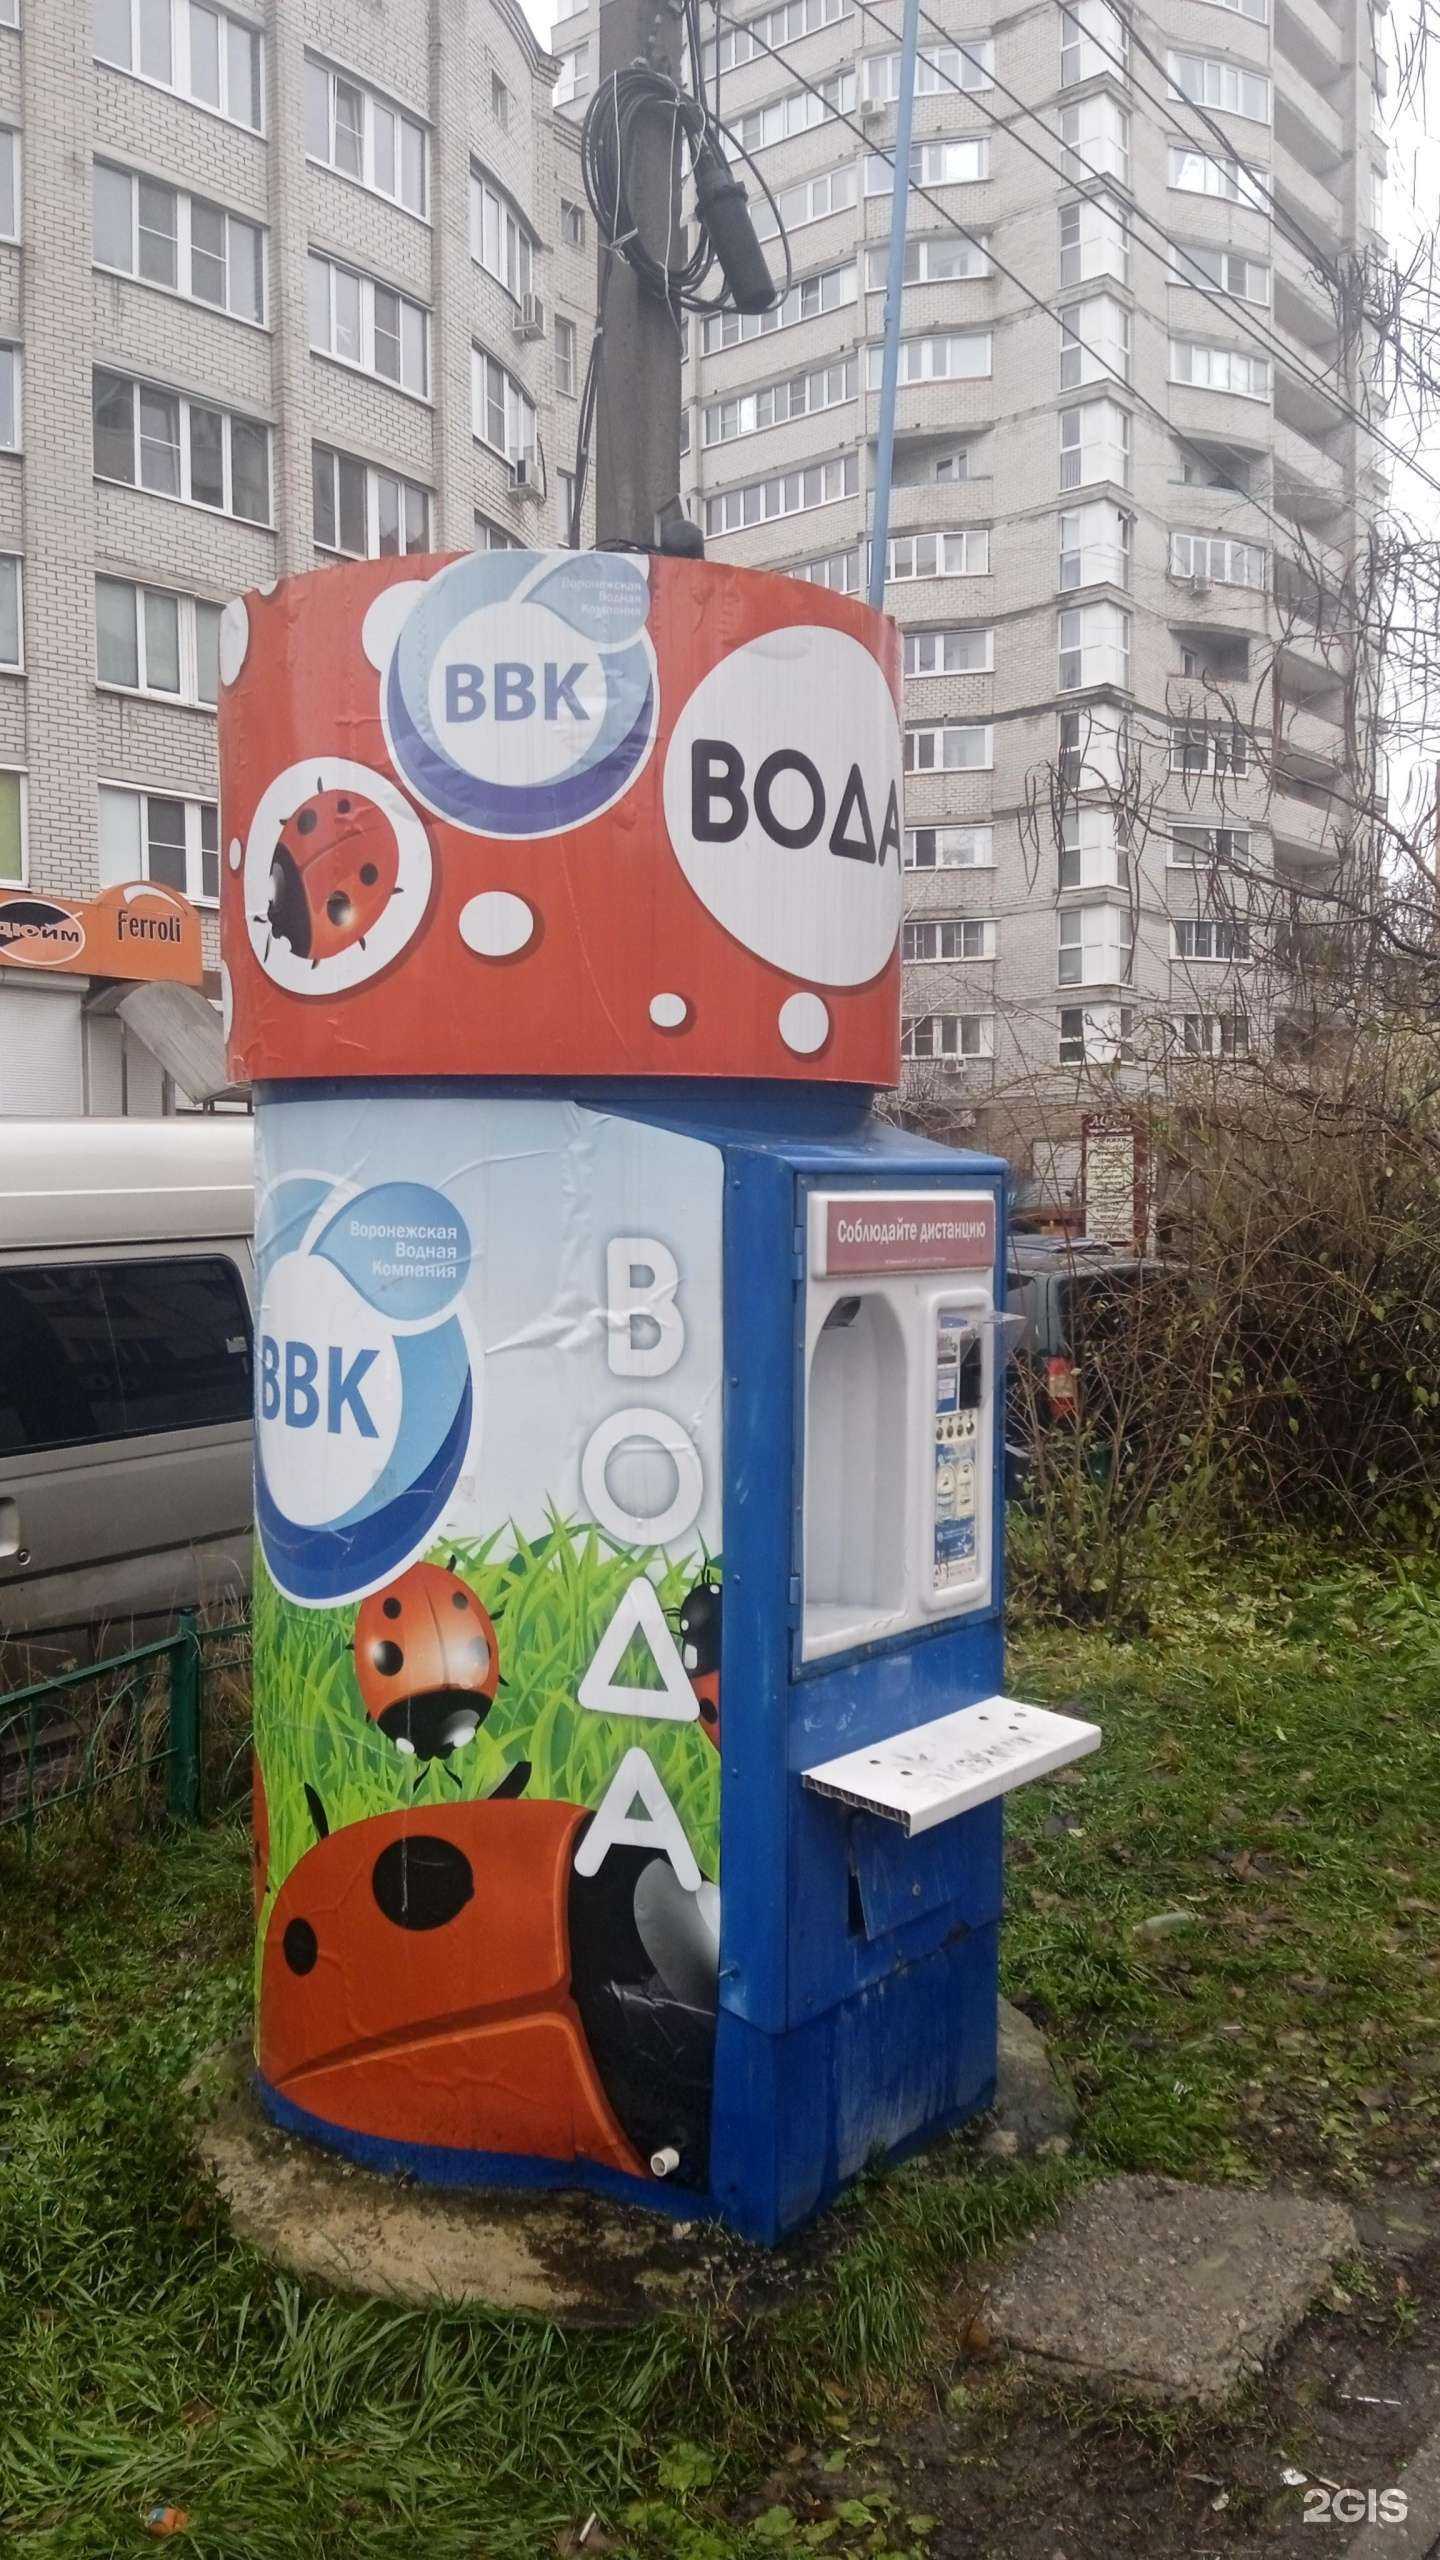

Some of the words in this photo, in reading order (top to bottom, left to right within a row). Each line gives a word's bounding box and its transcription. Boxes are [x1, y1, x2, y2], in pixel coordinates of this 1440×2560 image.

[445, 662, 591, 723] ВВК
[691, 738, 902, 876] ВОДА
[118, 909, 182, 943] Ferroli
[350, 1220, 457, 1241] Воронежская
[837, 1216, 918, 1244] Соблюдайте
[919, 1220, 986, 1243] дистанцию
[395, 1241, 457, 1260] Водная
[371, 1259, 457, 1279] Компания
[262, 1335, 380, 1438] ВВК
[574, 1236, 703, 1892] ВОДА
